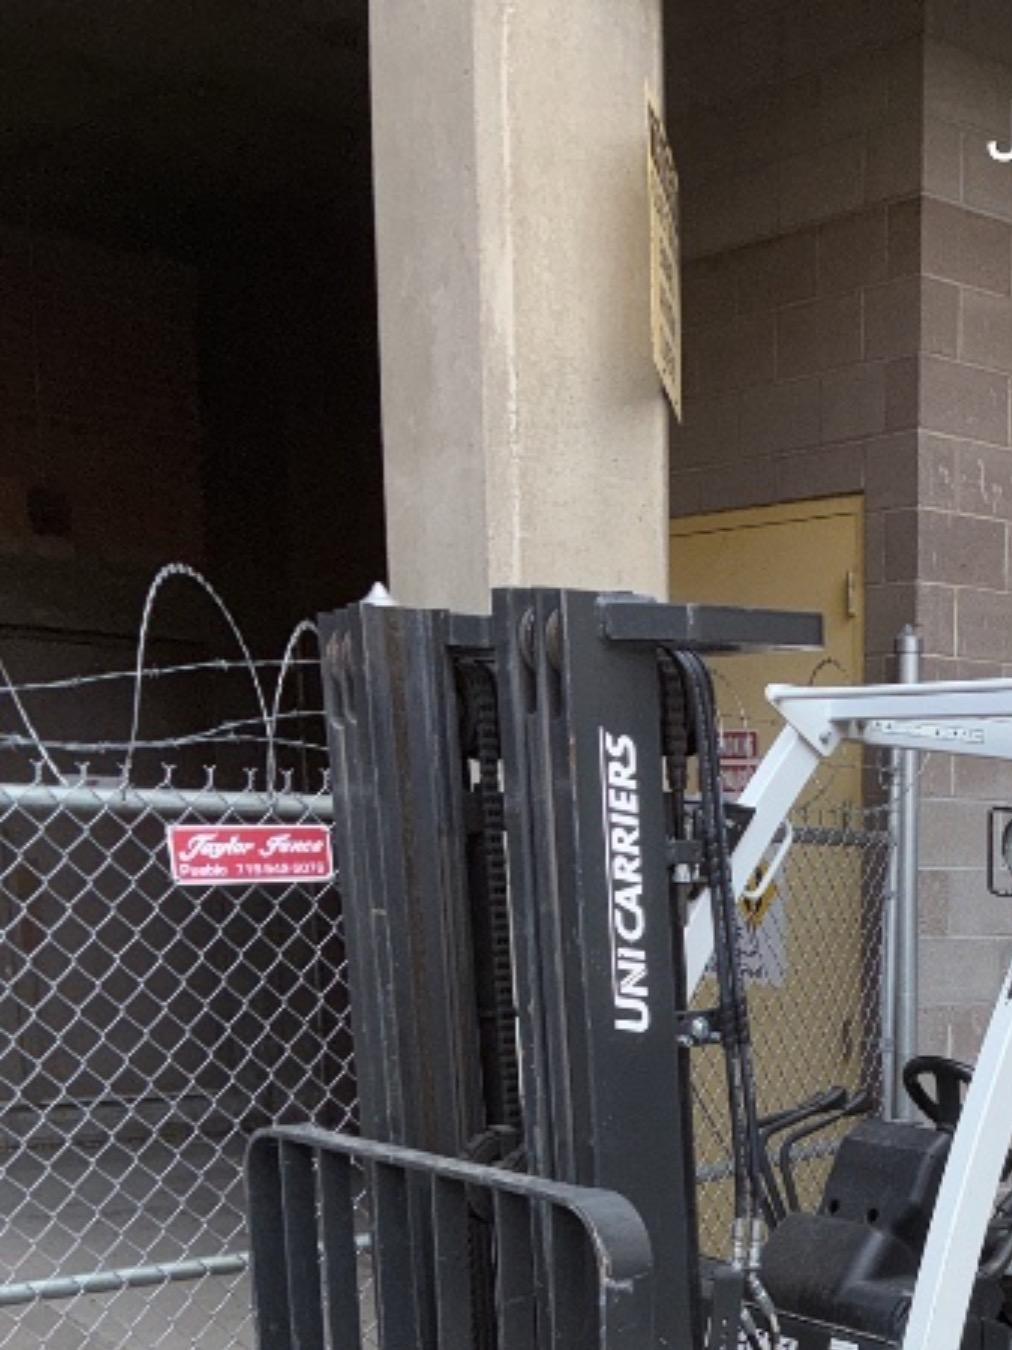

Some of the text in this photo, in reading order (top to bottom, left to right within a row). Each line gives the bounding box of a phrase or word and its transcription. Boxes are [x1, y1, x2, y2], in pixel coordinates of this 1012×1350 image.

[178, 832, 325, 862] Taylor Fence
[599, 726, 652, 1034] UNICARRIERS
